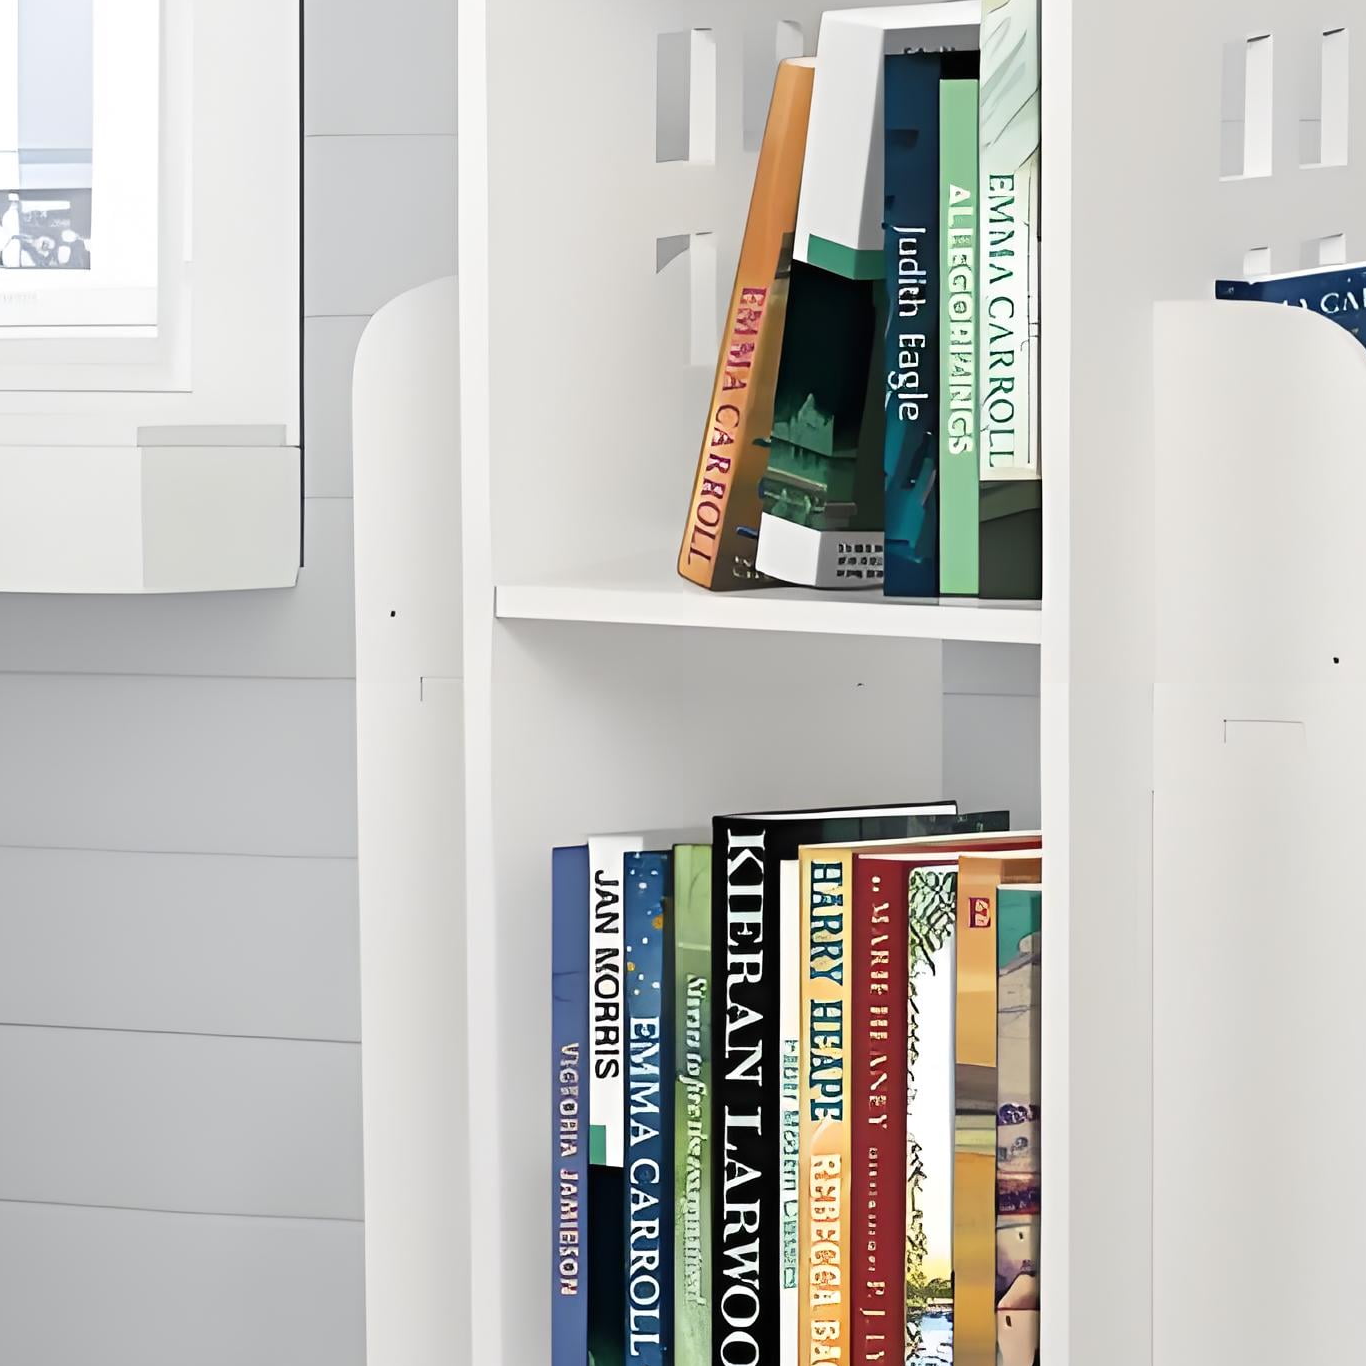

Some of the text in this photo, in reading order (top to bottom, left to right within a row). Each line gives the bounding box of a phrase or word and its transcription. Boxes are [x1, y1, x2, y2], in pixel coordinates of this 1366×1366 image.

[687, 286, 768, 566] EMMA CARROLL
[887, 225, 927, 423] Judith Eagle
[987, 173, 1015, 467] EMMA CARROLL
[593, 869, 620, 1080] JAN MORRIS
[723, 828, 767, 1088] KIERAN
[809, 859, 844, 1124] HARRY HEAPE
[868, 901, 890, 996] MARIE
[558, 1041, 580, 1158] VICTORIA
[629, 1015, 661, 1357] EMMA CARROLL
[868, 1006, 890, 1131] HEANEY
